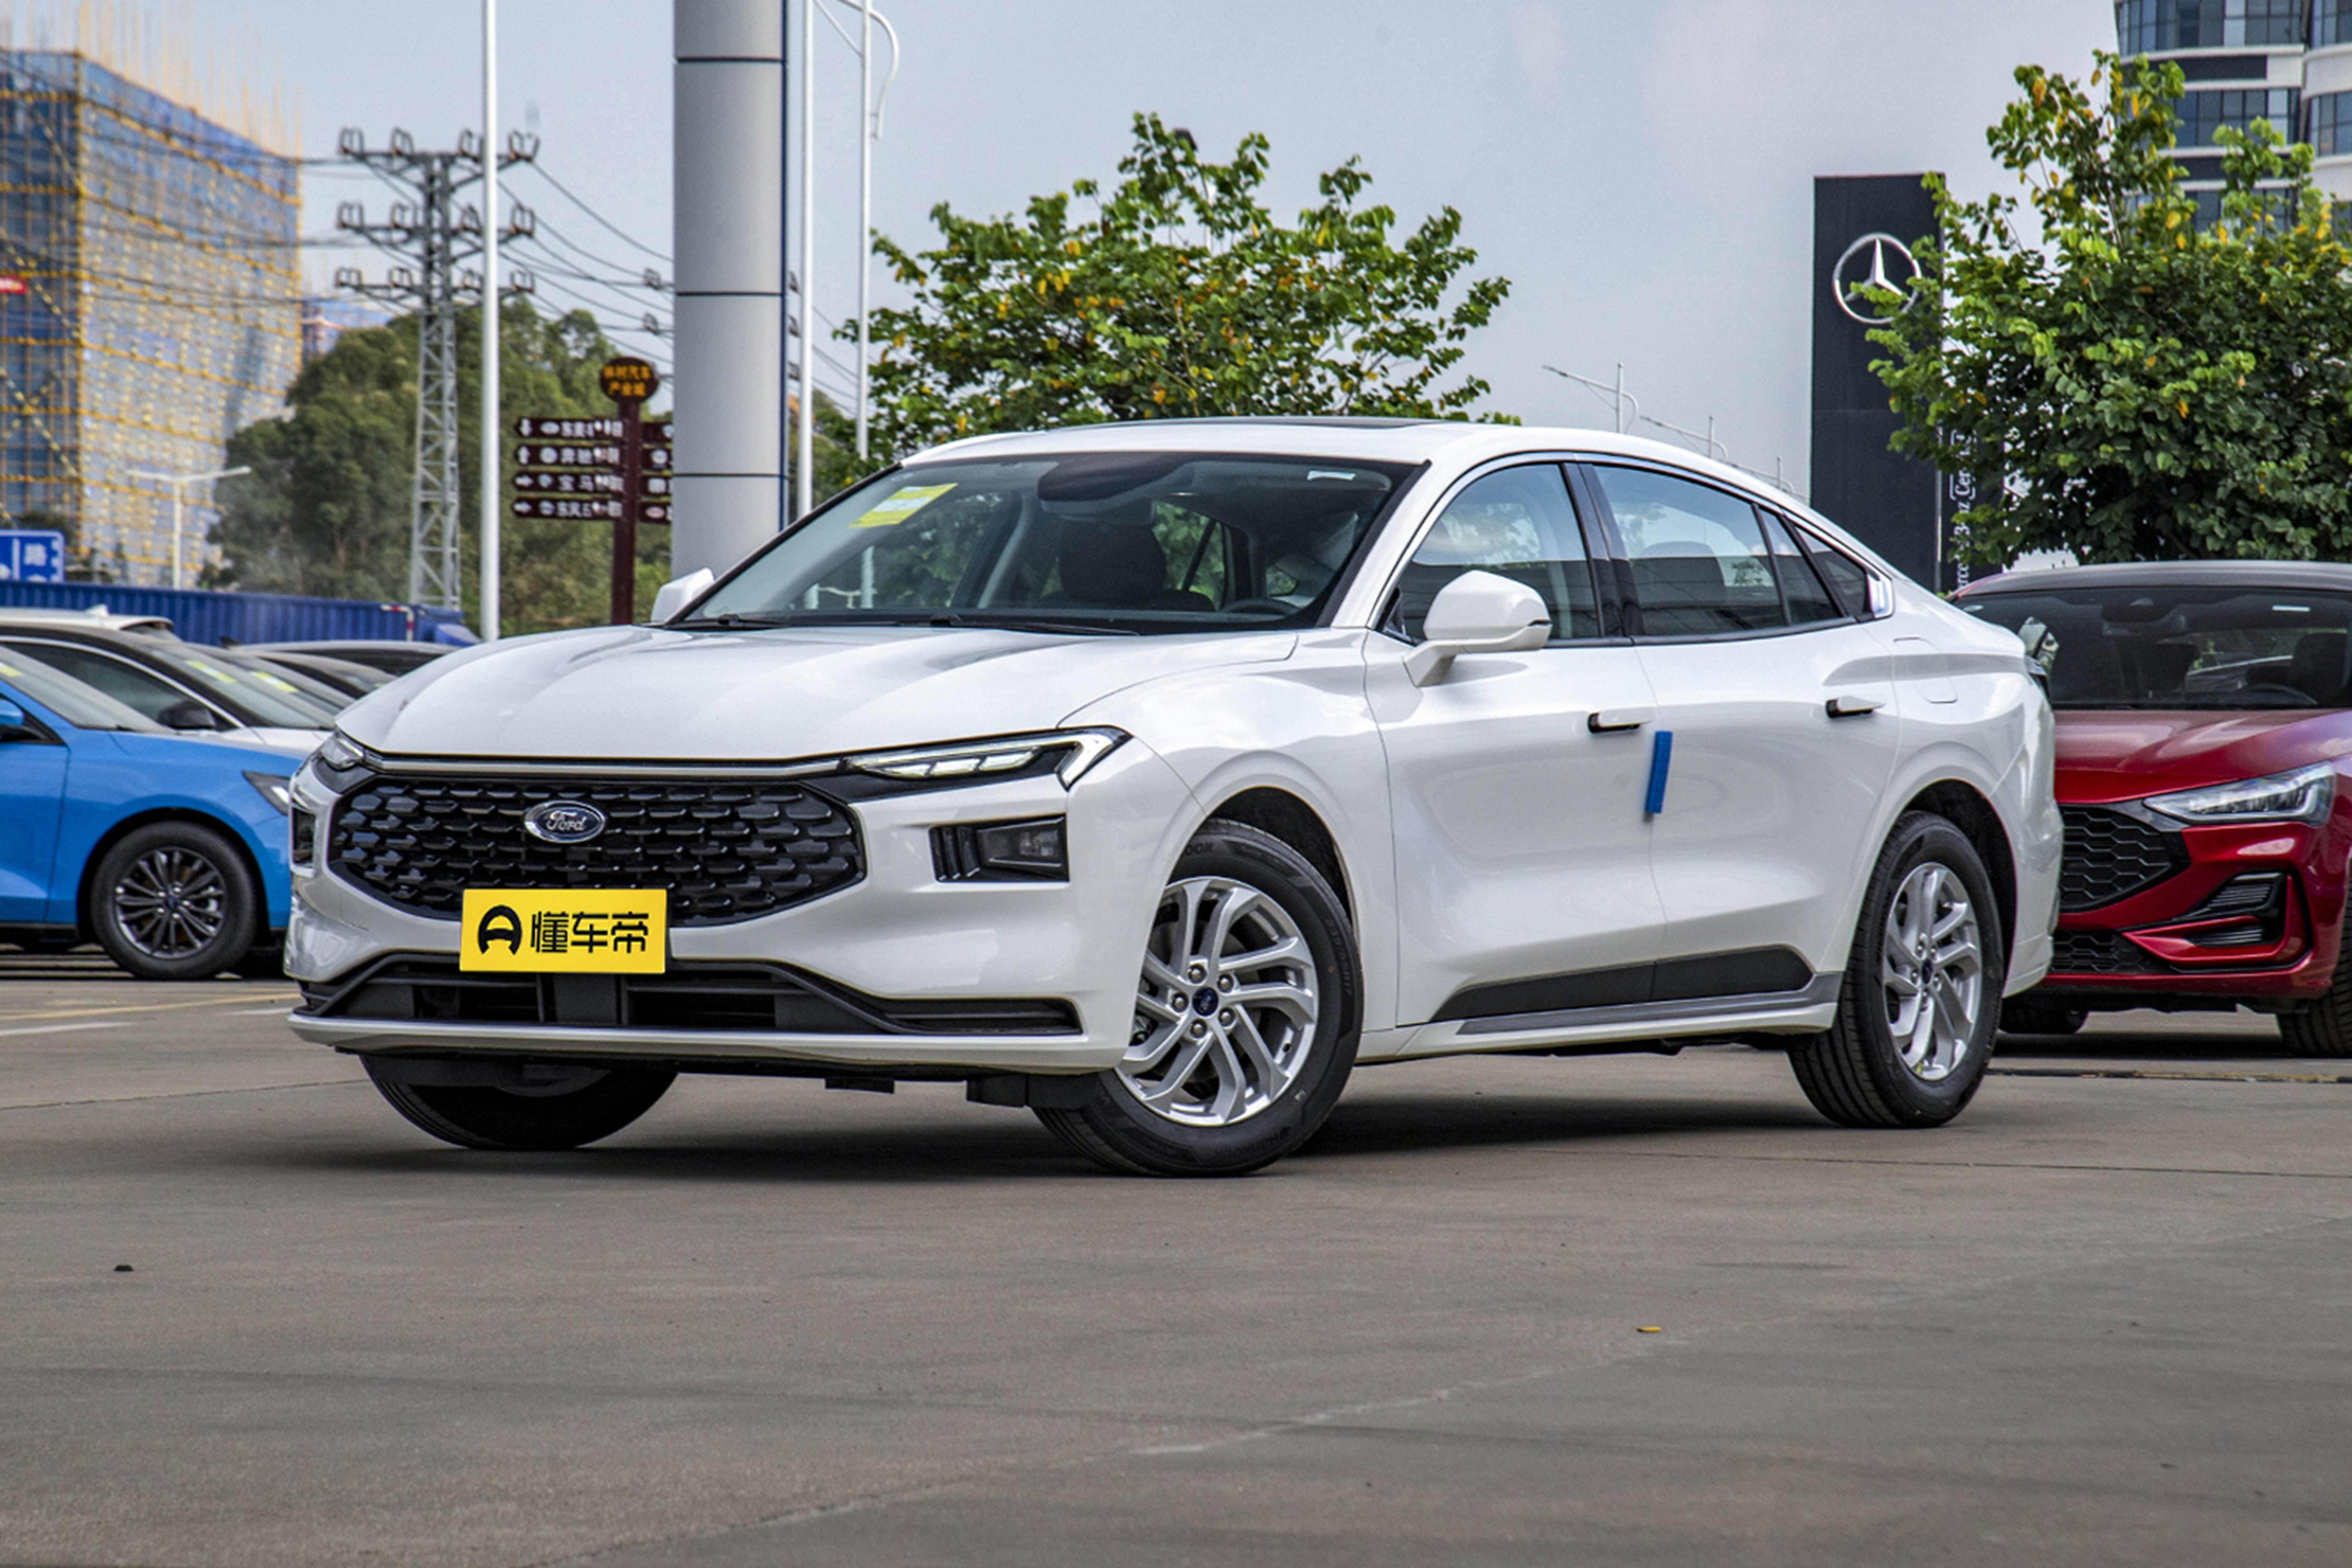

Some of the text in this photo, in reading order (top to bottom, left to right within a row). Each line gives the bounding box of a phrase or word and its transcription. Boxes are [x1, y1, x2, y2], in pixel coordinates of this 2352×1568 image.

[546, 810, 587, 831] Ford
[530, 910, 649, 954] 懂车帝
